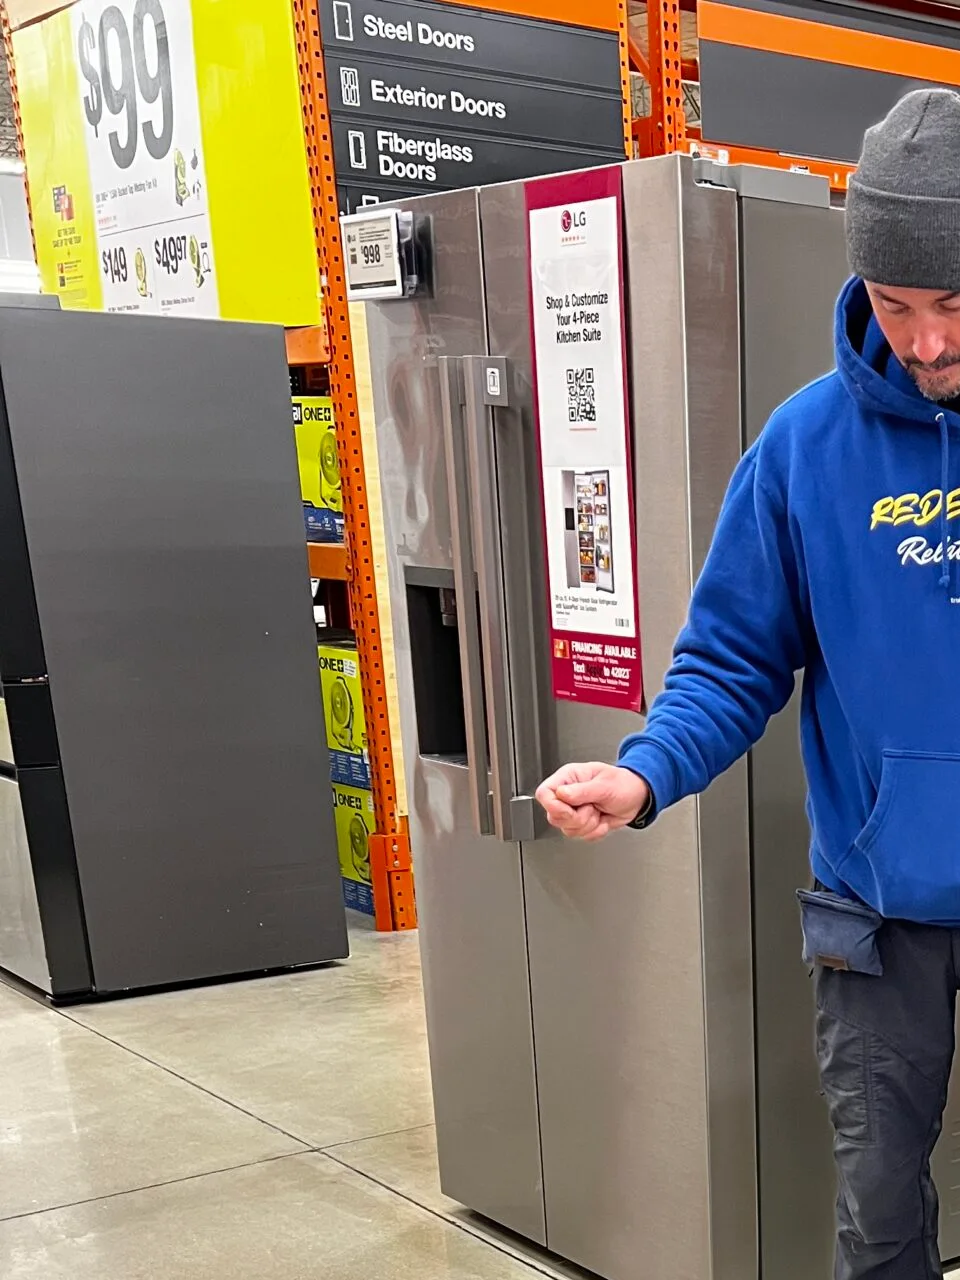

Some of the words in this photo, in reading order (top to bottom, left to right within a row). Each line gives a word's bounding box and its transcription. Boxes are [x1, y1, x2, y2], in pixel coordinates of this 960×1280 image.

[363, 14, 414, 43] Steel
[418, 23, 475, 52] Doors
[77, 0, 174, 169] $99
[370, 80, 447, 110] Exterior
[451, 91, 507, 119] Doors
[376, 130, 474, 162] Fiberglass
[379, 155, 437, 182] Doors
[573, 211, 586, 228] LG
[102, 246, 128, 284] $149
[546, 293, 563, 310] Shop
[564, 295, 570, 305] &
[571, 291, 608, 307] Customize
[556, 313, 571, 327] Your
[572, 310, 600, 325] 4-Piece
[556, 329, 581, 344] Kitchen
[582, 328, 601, 342] Suite
